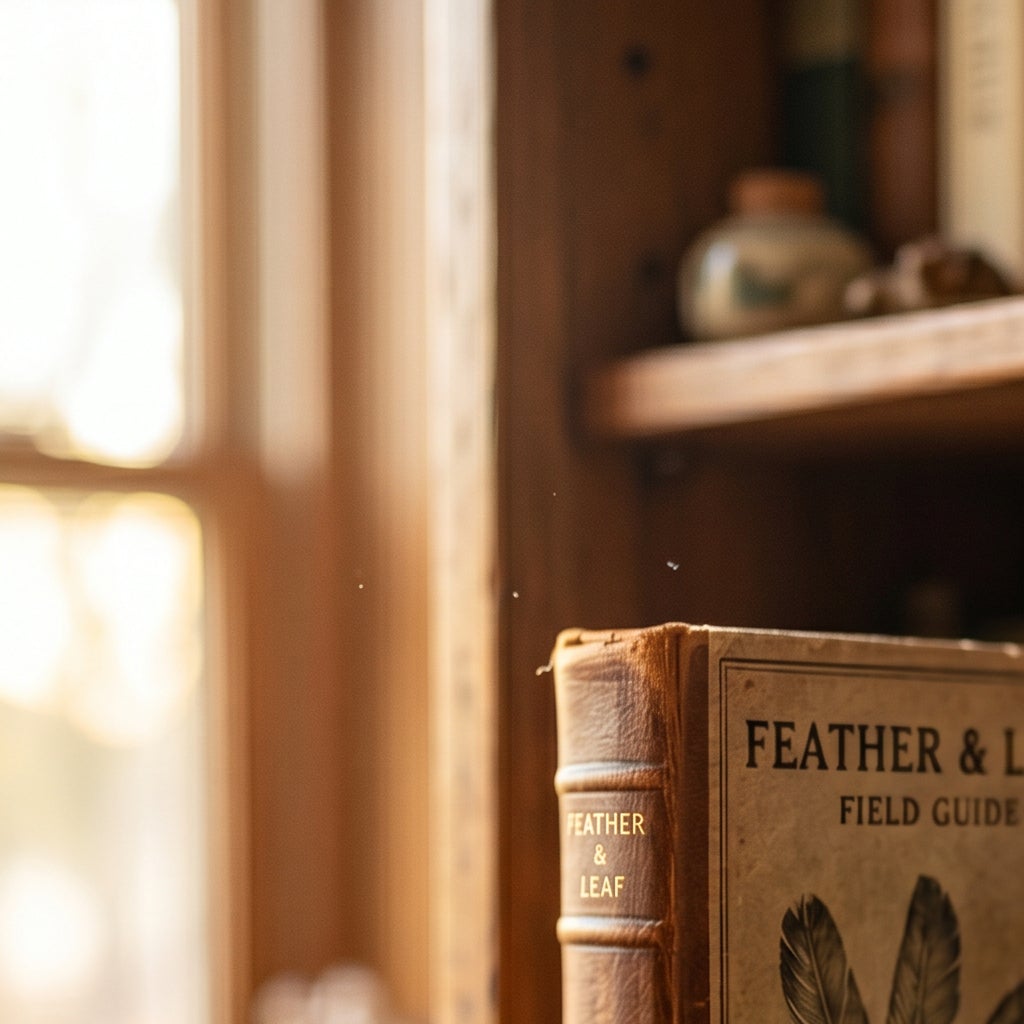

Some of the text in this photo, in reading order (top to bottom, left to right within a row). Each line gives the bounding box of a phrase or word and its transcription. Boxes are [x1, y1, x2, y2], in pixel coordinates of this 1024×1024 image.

[746, 720, 941, 773] FEATHER
[959, 728, 987, 775] &
[840, 796, 1019, 826] FIELD GUIDE
[567, 812, 645, 836] FEATHER
[594, 843, 607, 866] &
[580, 876, 625, 898] LEAF
